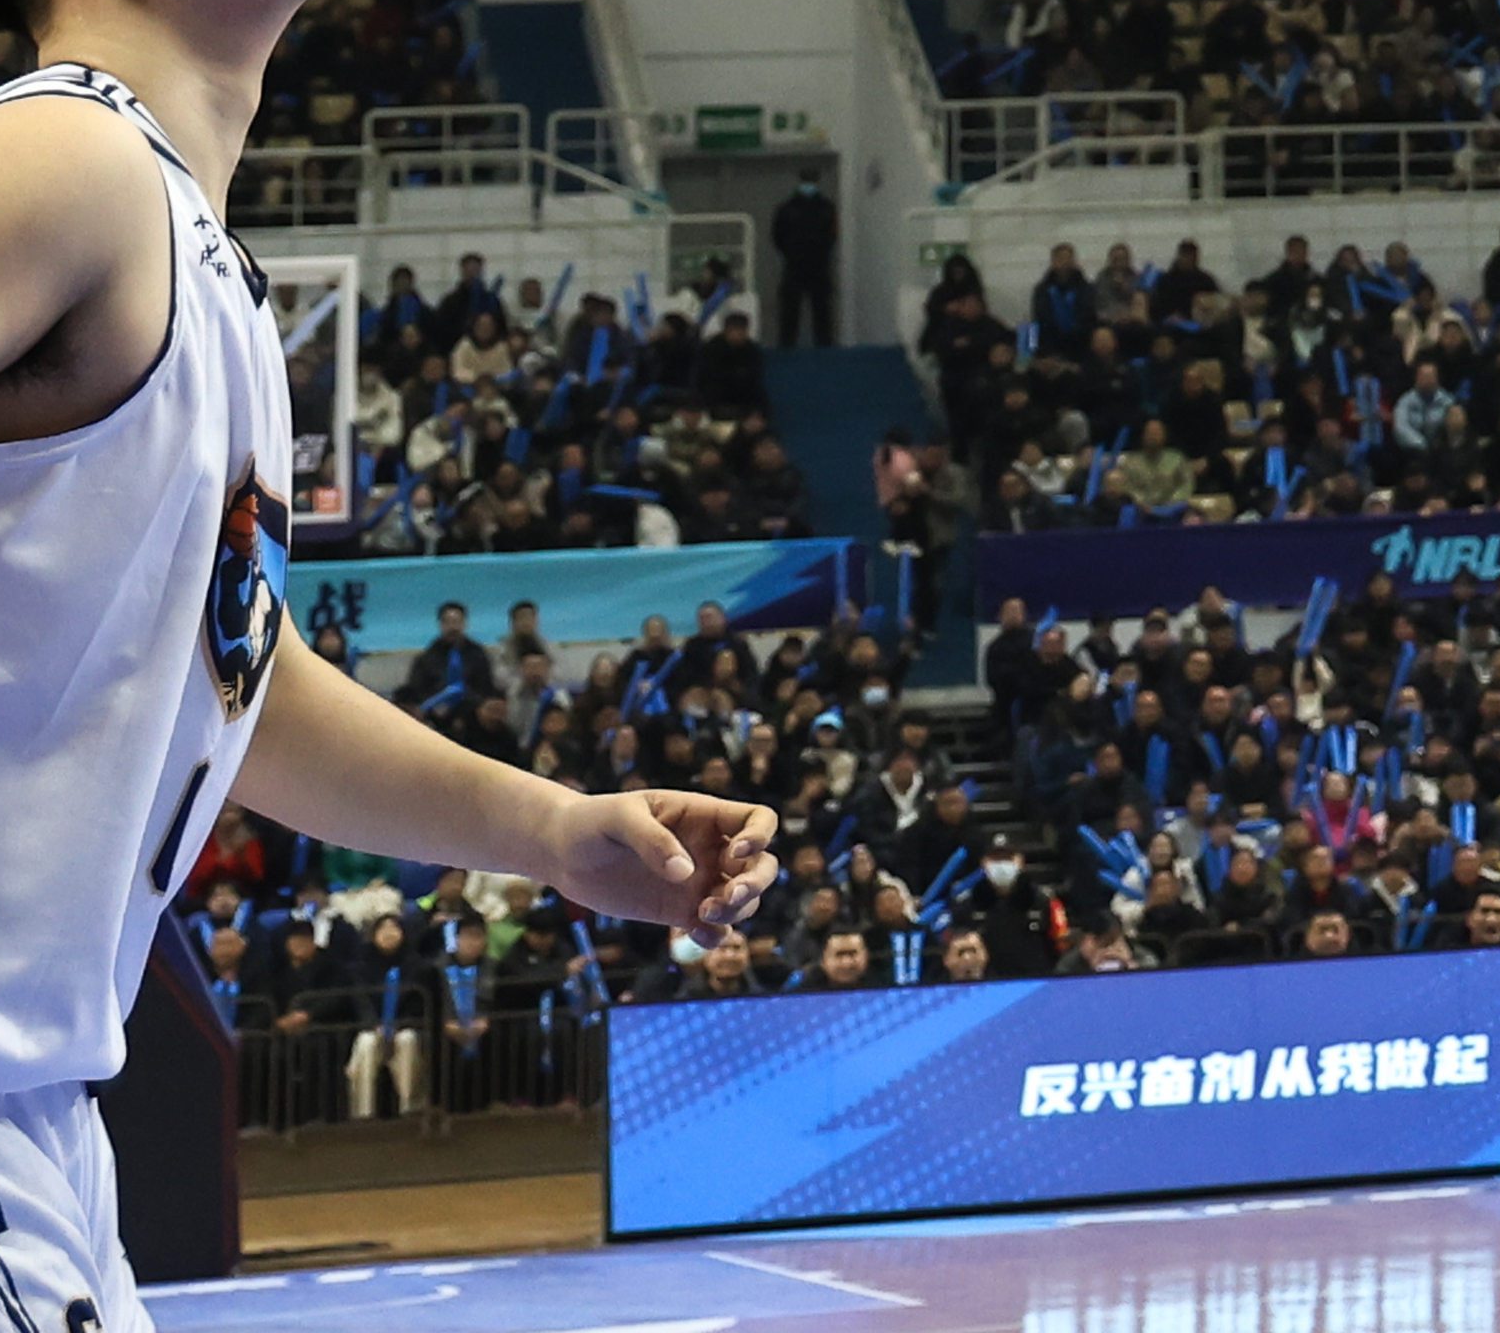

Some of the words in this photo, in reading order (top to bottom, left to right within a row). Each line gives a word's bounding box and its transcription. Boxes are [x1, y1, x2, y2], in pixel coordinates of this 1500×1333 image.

[1018, 1033, 1491, 1117] 反兴奋剂从我做起
